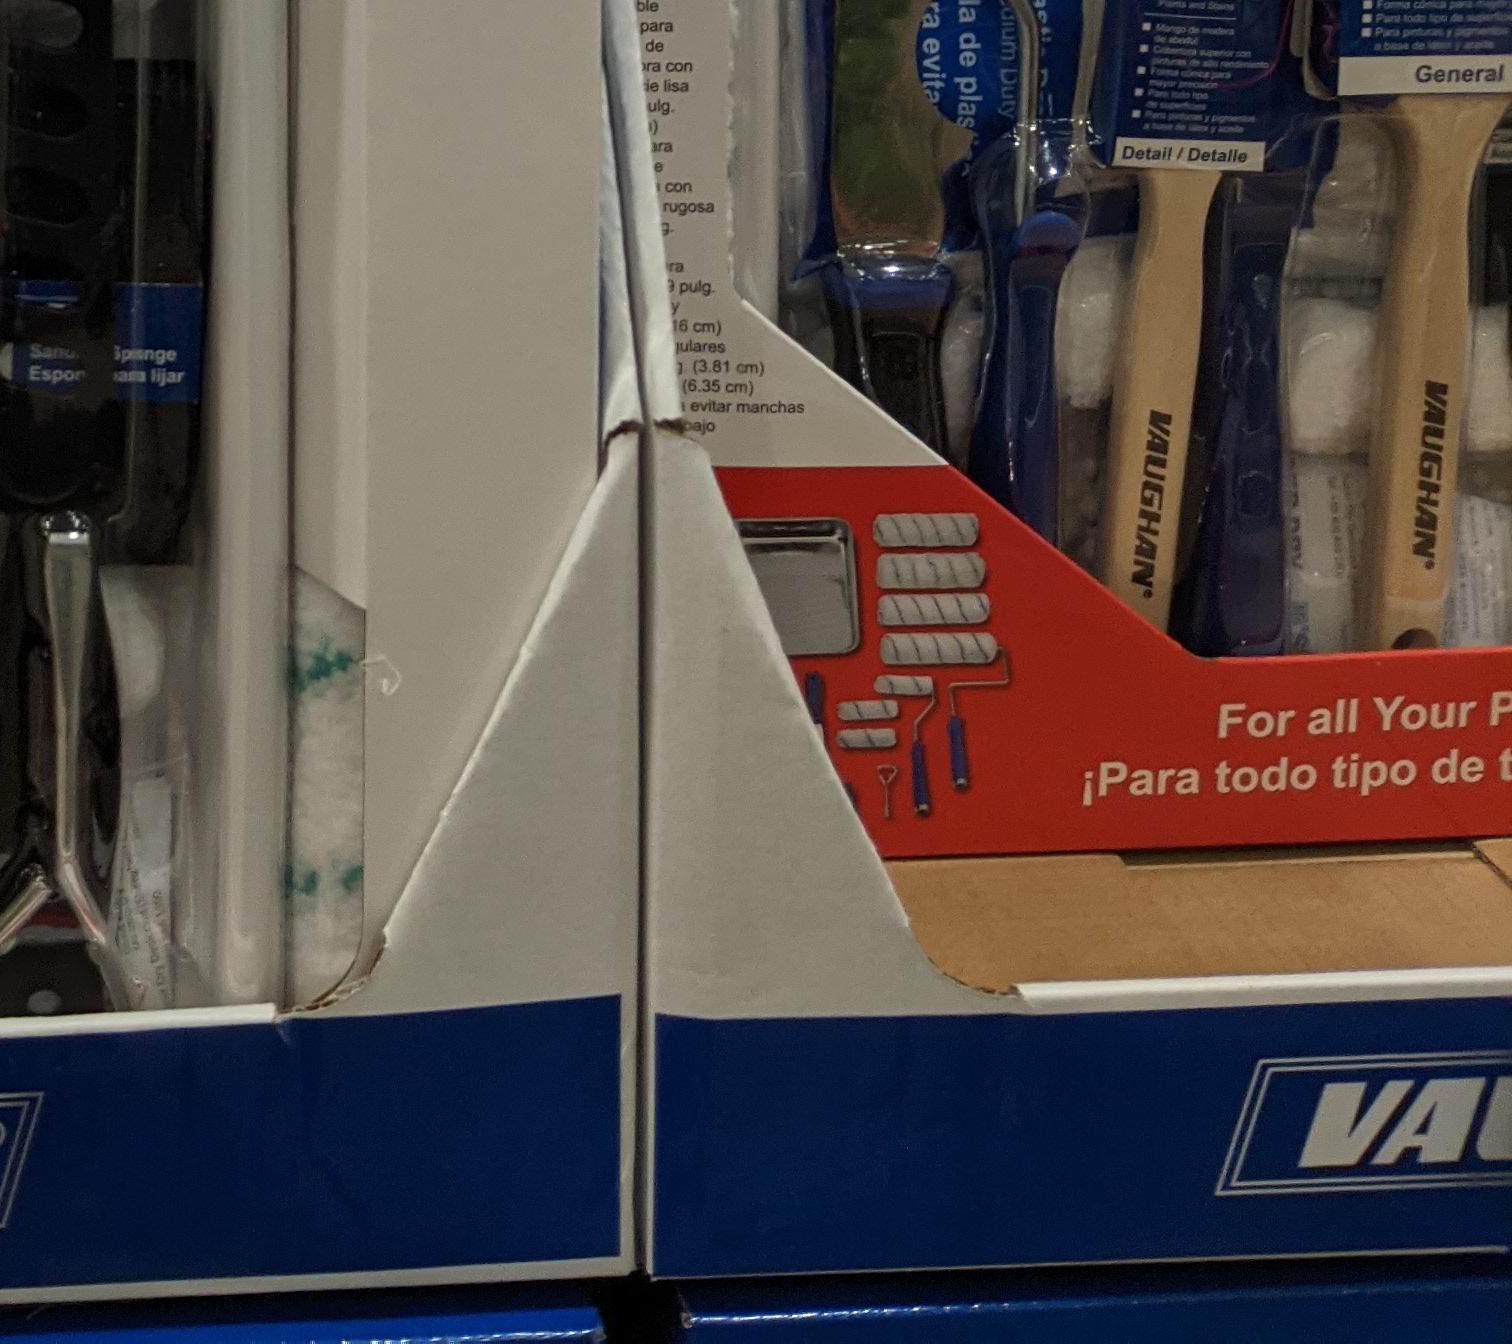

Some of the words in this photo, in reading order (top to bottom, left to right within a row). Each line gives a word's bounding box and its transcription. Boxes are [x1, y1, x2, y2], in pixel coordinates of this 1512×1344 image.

[1415, 64, 1505, 84] General
[1122, 145, 1172, 162] Detail
[1187, 146, 1248, 165] Detalle
[690, 400, 733, 414] evitar
[737, 401, 805, 415] manchas
[1217, 703, 1295, 739] For
[1307, 698, 1360, 735] all
[1373, 695, 1478, 732] Your
[1082, 760, 1201, 807] ¡Para
[1215, 758, 1318, 794] todo
[1331, 753, 1418, 797] tipo
[1431, 749, 1486, 784] de
